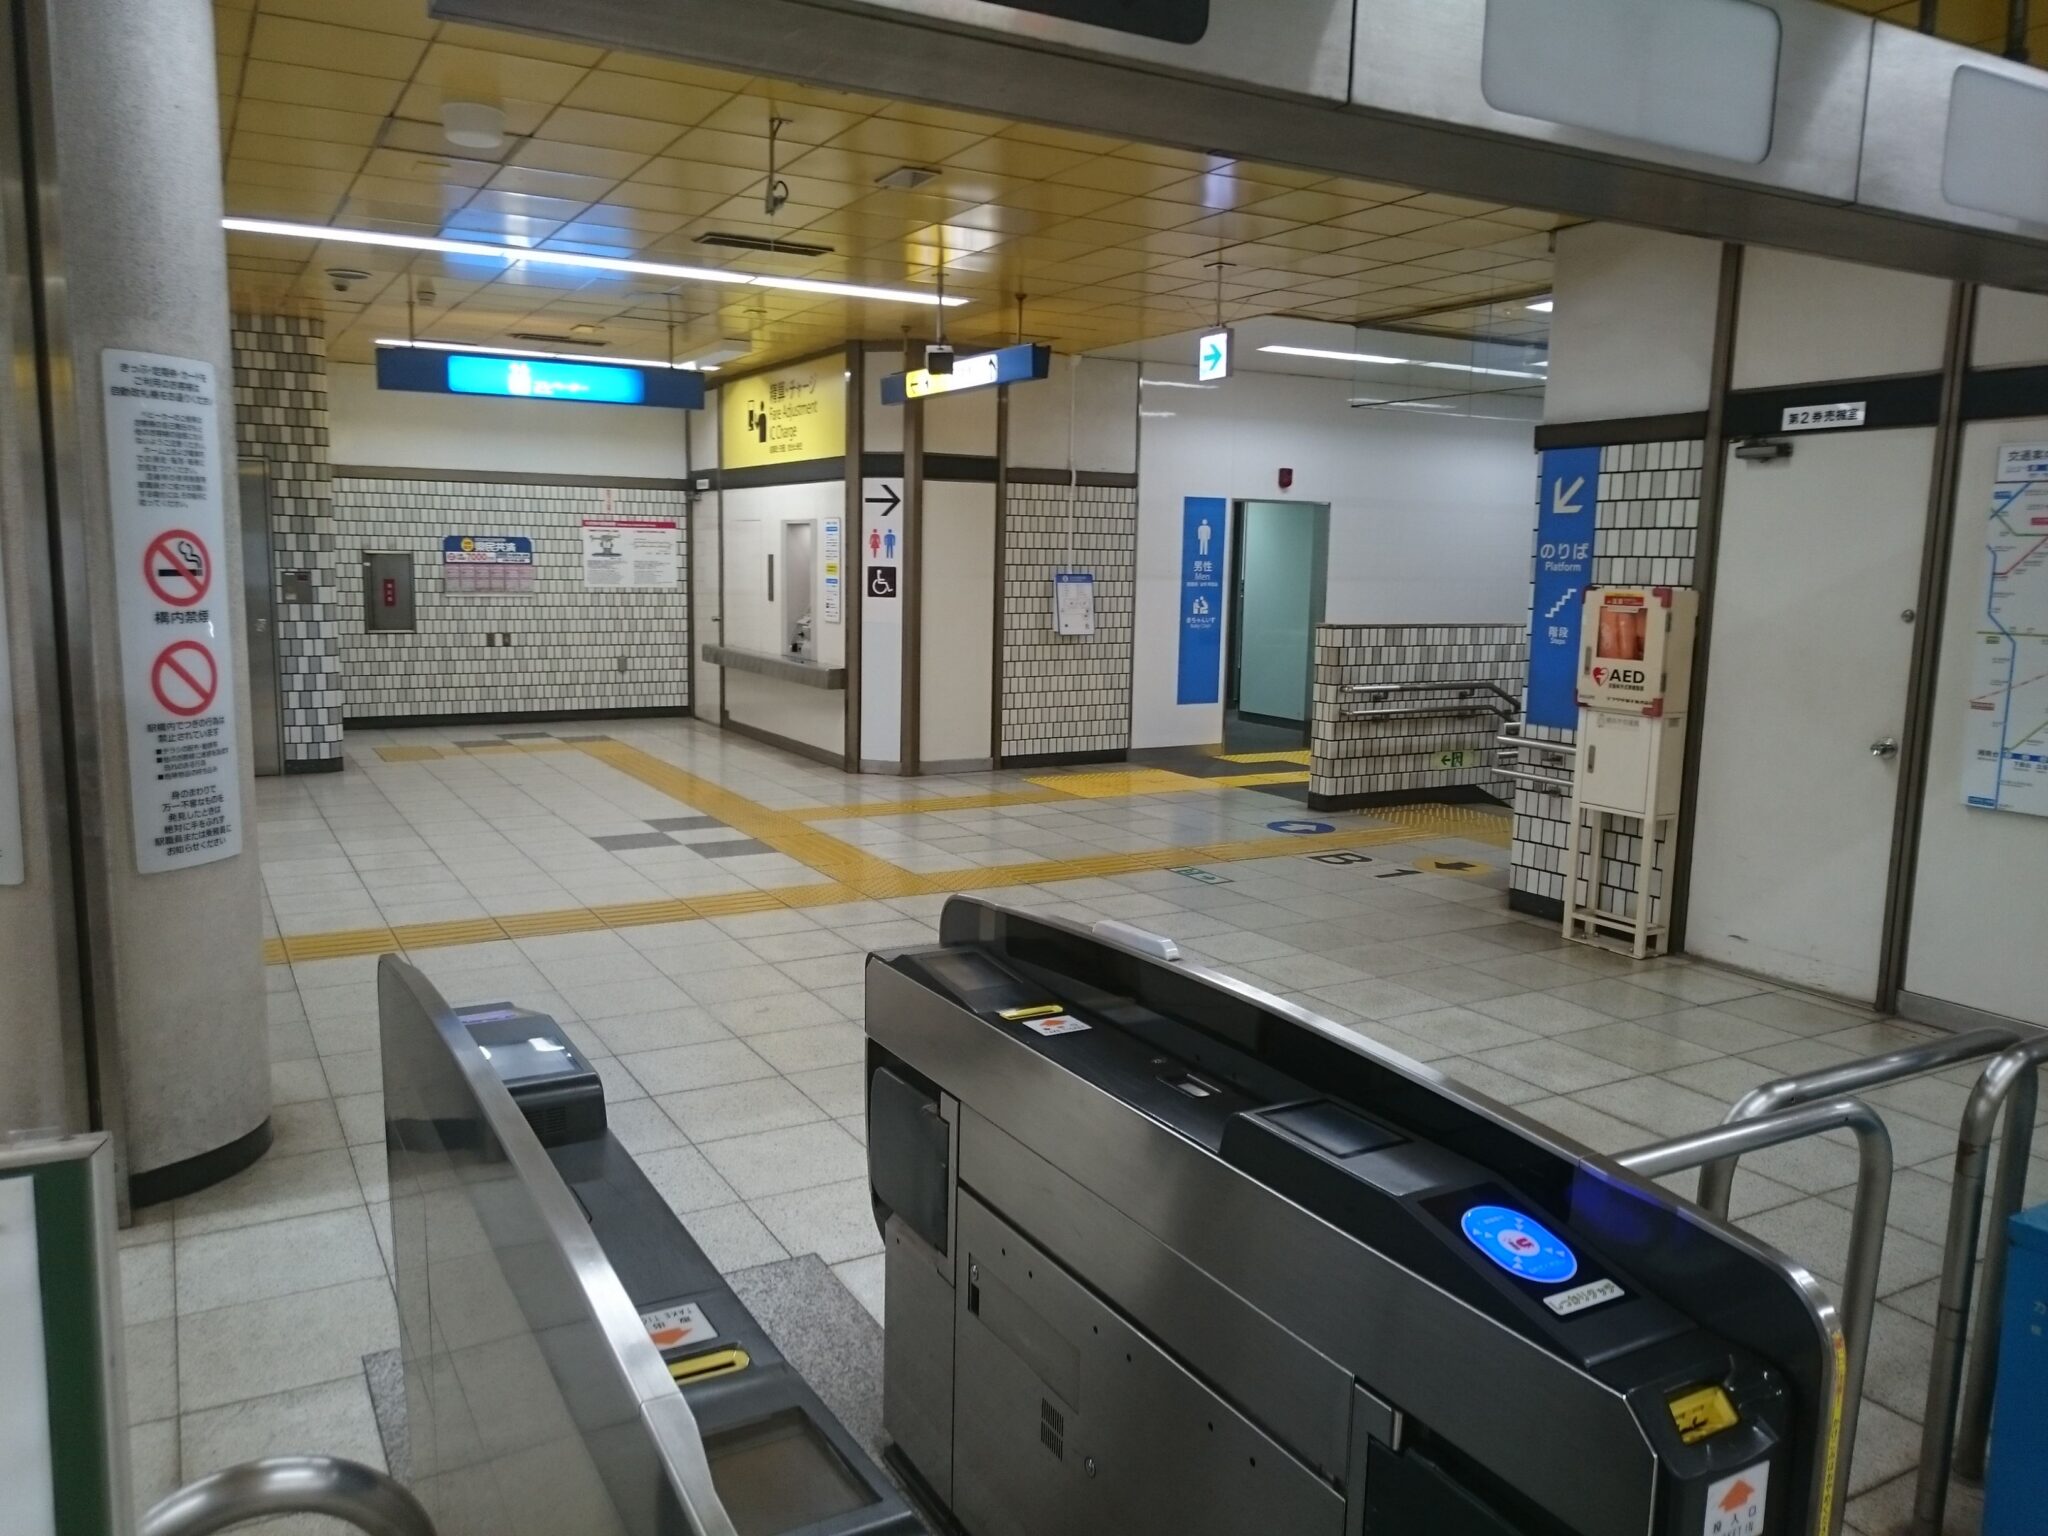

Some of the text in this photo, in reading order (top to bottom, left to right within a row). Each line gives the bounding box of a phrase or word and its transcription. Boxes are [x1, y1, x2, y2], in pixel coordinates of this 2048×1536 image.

[1540, 543, 1589, 560] のりば
[1193, 560, 1213, 572] 男性
[1544, 561, 1582, 572] Platform
[1194, 572, 1210, 580] Men
[154, 610, 209, 625] 構内禁煙
[1548, 626, 1568, 638] 階段
[1609, 669, 1645, 684] AED
[158, 728, 219, 743] 禁止されています
[171, 785, 217, 800] 身のまわりで
[168, 805, 222, 823] 発見したときは
[167, 837, 226, 857] お知らせください
